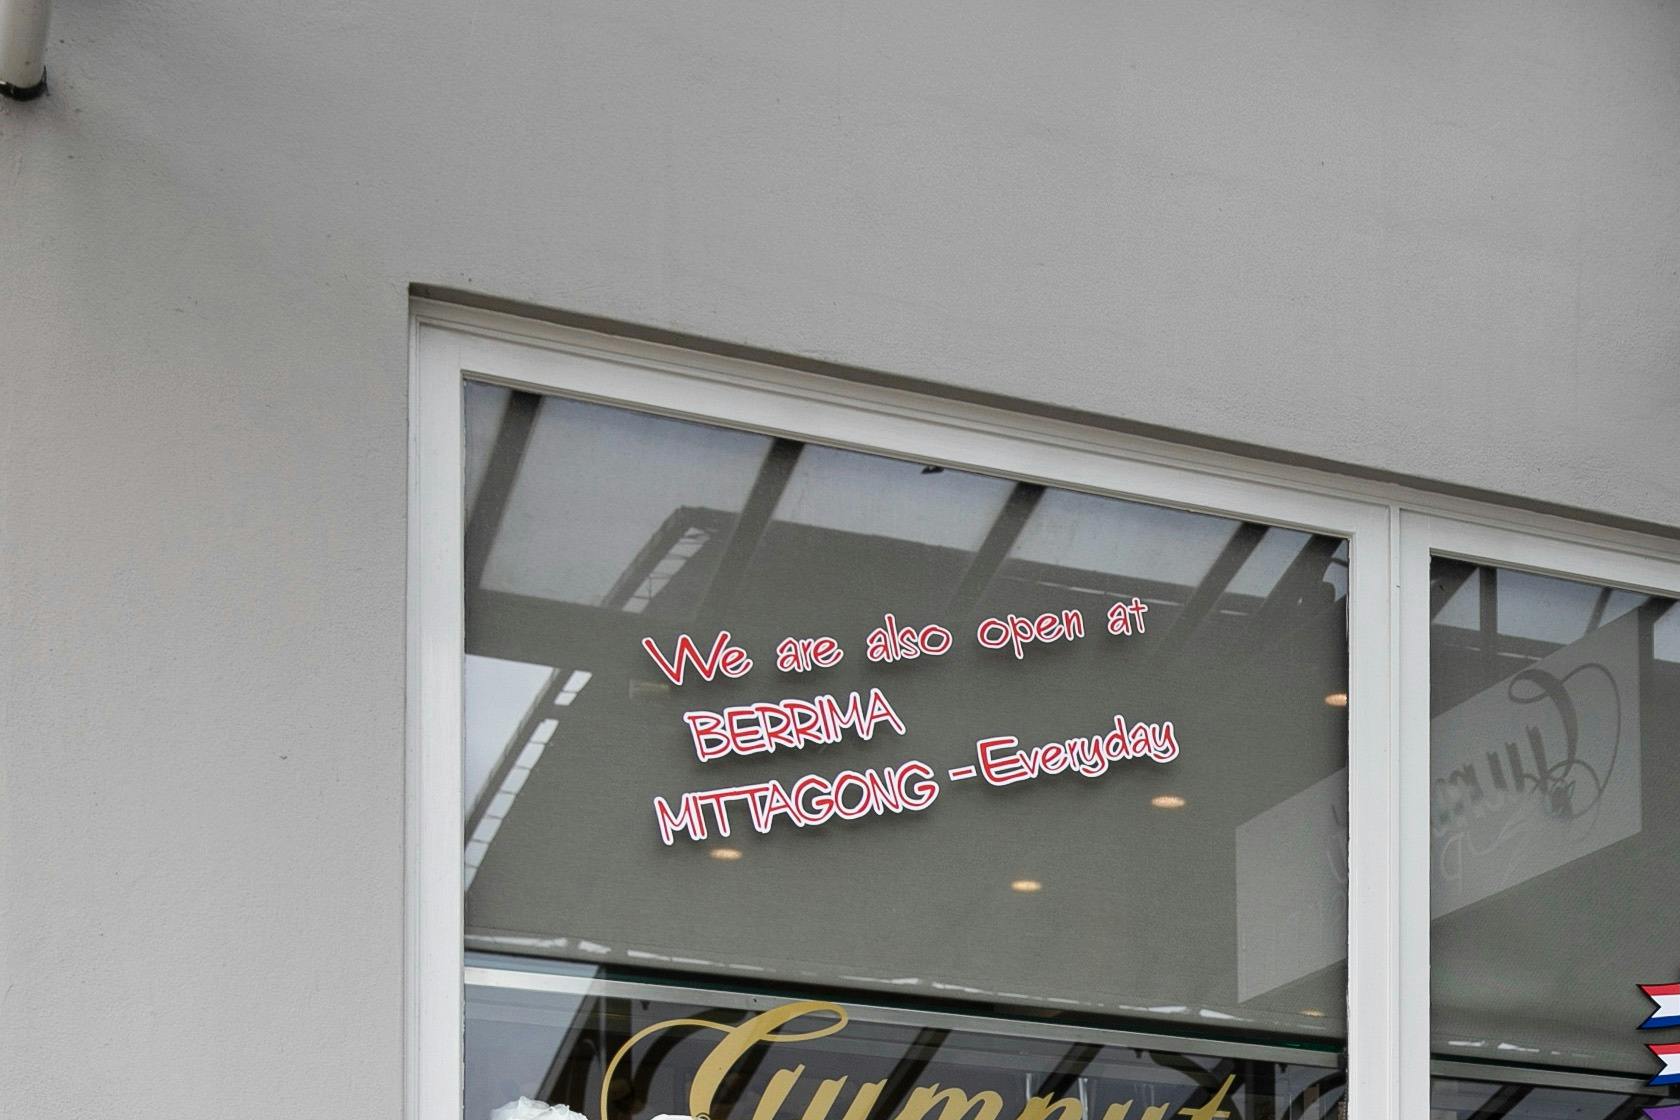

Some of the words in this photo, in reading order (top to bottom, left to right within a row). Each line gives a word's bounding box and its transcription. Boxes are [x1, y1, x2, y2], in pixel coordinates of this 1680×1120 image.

[642, 631, 753, 685] We
[777, 637, 843, 672] are
[867, 613, 952, 662] also
[977, 609, 1084, 659] open
[1107, 597, 1148, 636] at
[684, 688, 906, 762] BERRIMA
[654, 761, 939, 845] MITTAGONG
